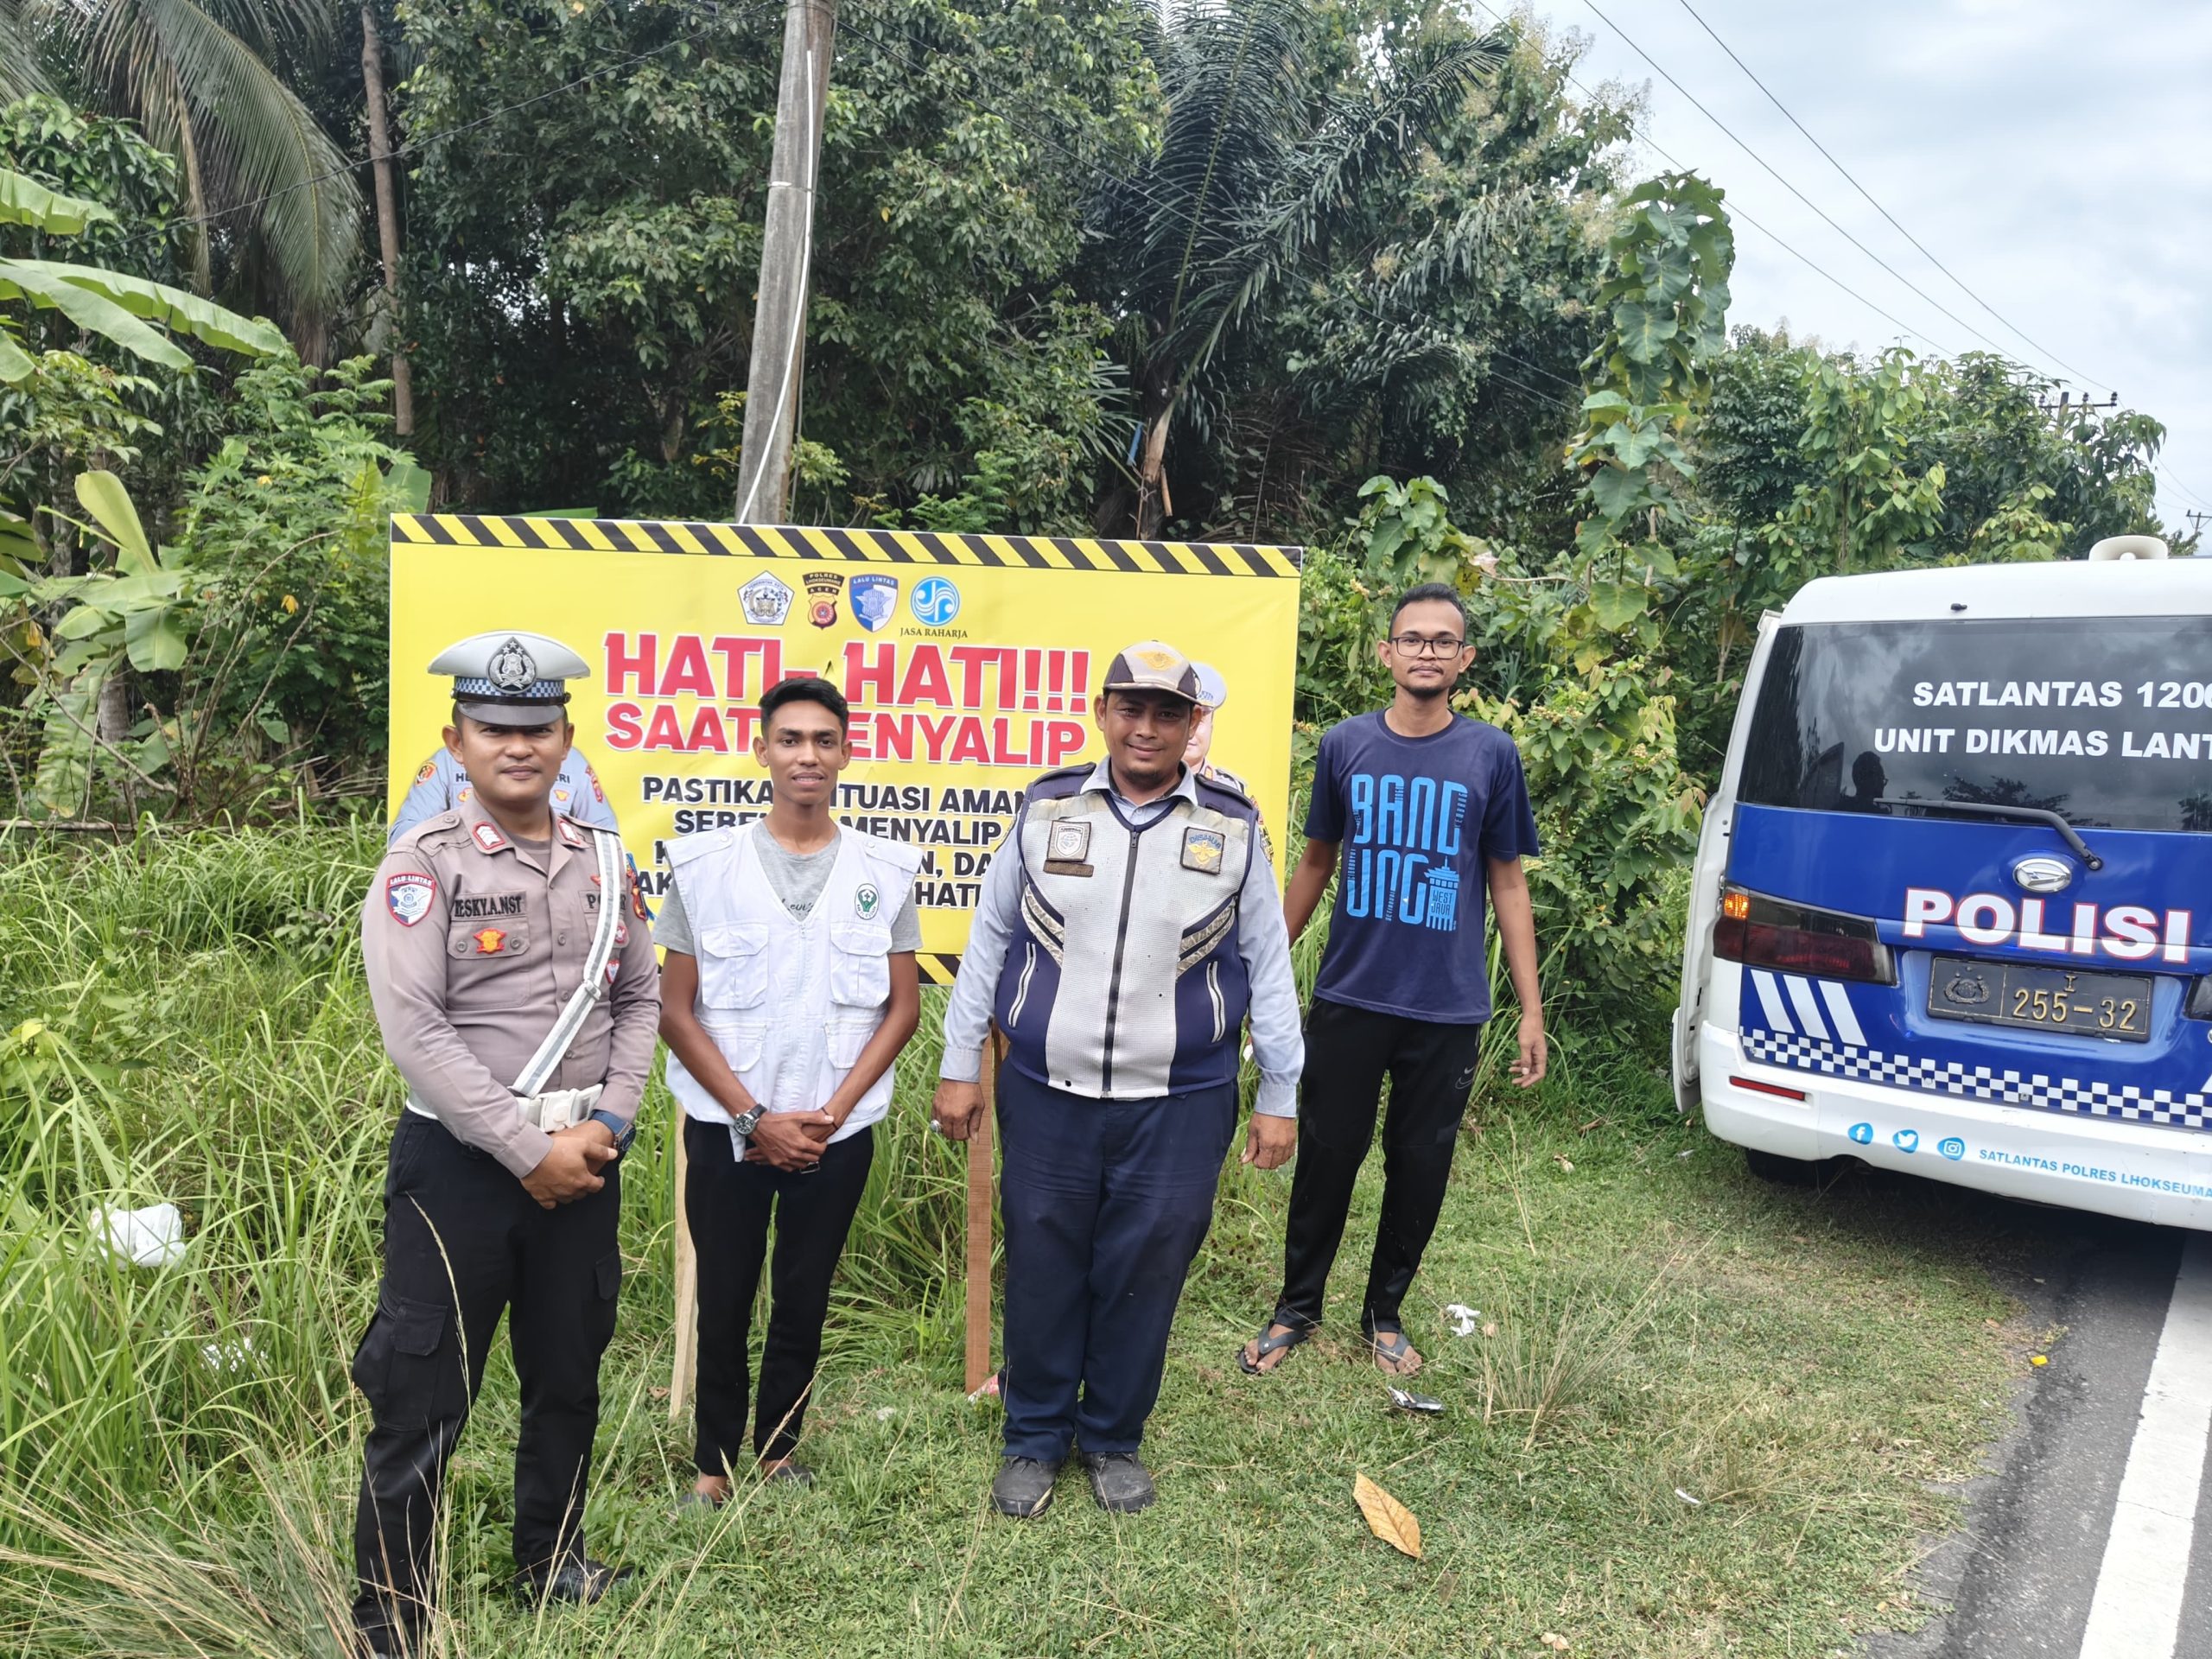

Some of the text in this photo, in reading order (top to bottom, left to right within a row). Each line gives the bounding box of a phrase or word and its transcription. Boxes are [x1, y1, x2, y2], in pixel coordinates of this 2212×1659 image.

[871, 575, 895, 586] LINTAS
[900, 627, 968, 639] JASA RAHARJA
[844, 643, 1089, 713] HATI!!!
[1913, 682, 2122, 708] SATLANTAS
[607, 703, 1085, 766] SAAT ENYALIP
[1874, 728, 1955, 753] UNIT
[1966, 729, 2108, 756] DIKMAS
[643, 777, 773, 804] PASTIKA
[830, 784, 929, 811] ITUASI
[390, 874, 432, 886] LALU LINTAS
[1431, 902, 1451, 916] JAVA
[1432, 890, 1453, 904] WEST
[1902, 887, 2191, 964] POLISI
[2012, 988, 2139, 1031] 255-32
[1980, 1148, 2058, 1172] SATLANTAS
[2063, 1163, 2117, 1182] POLRES
